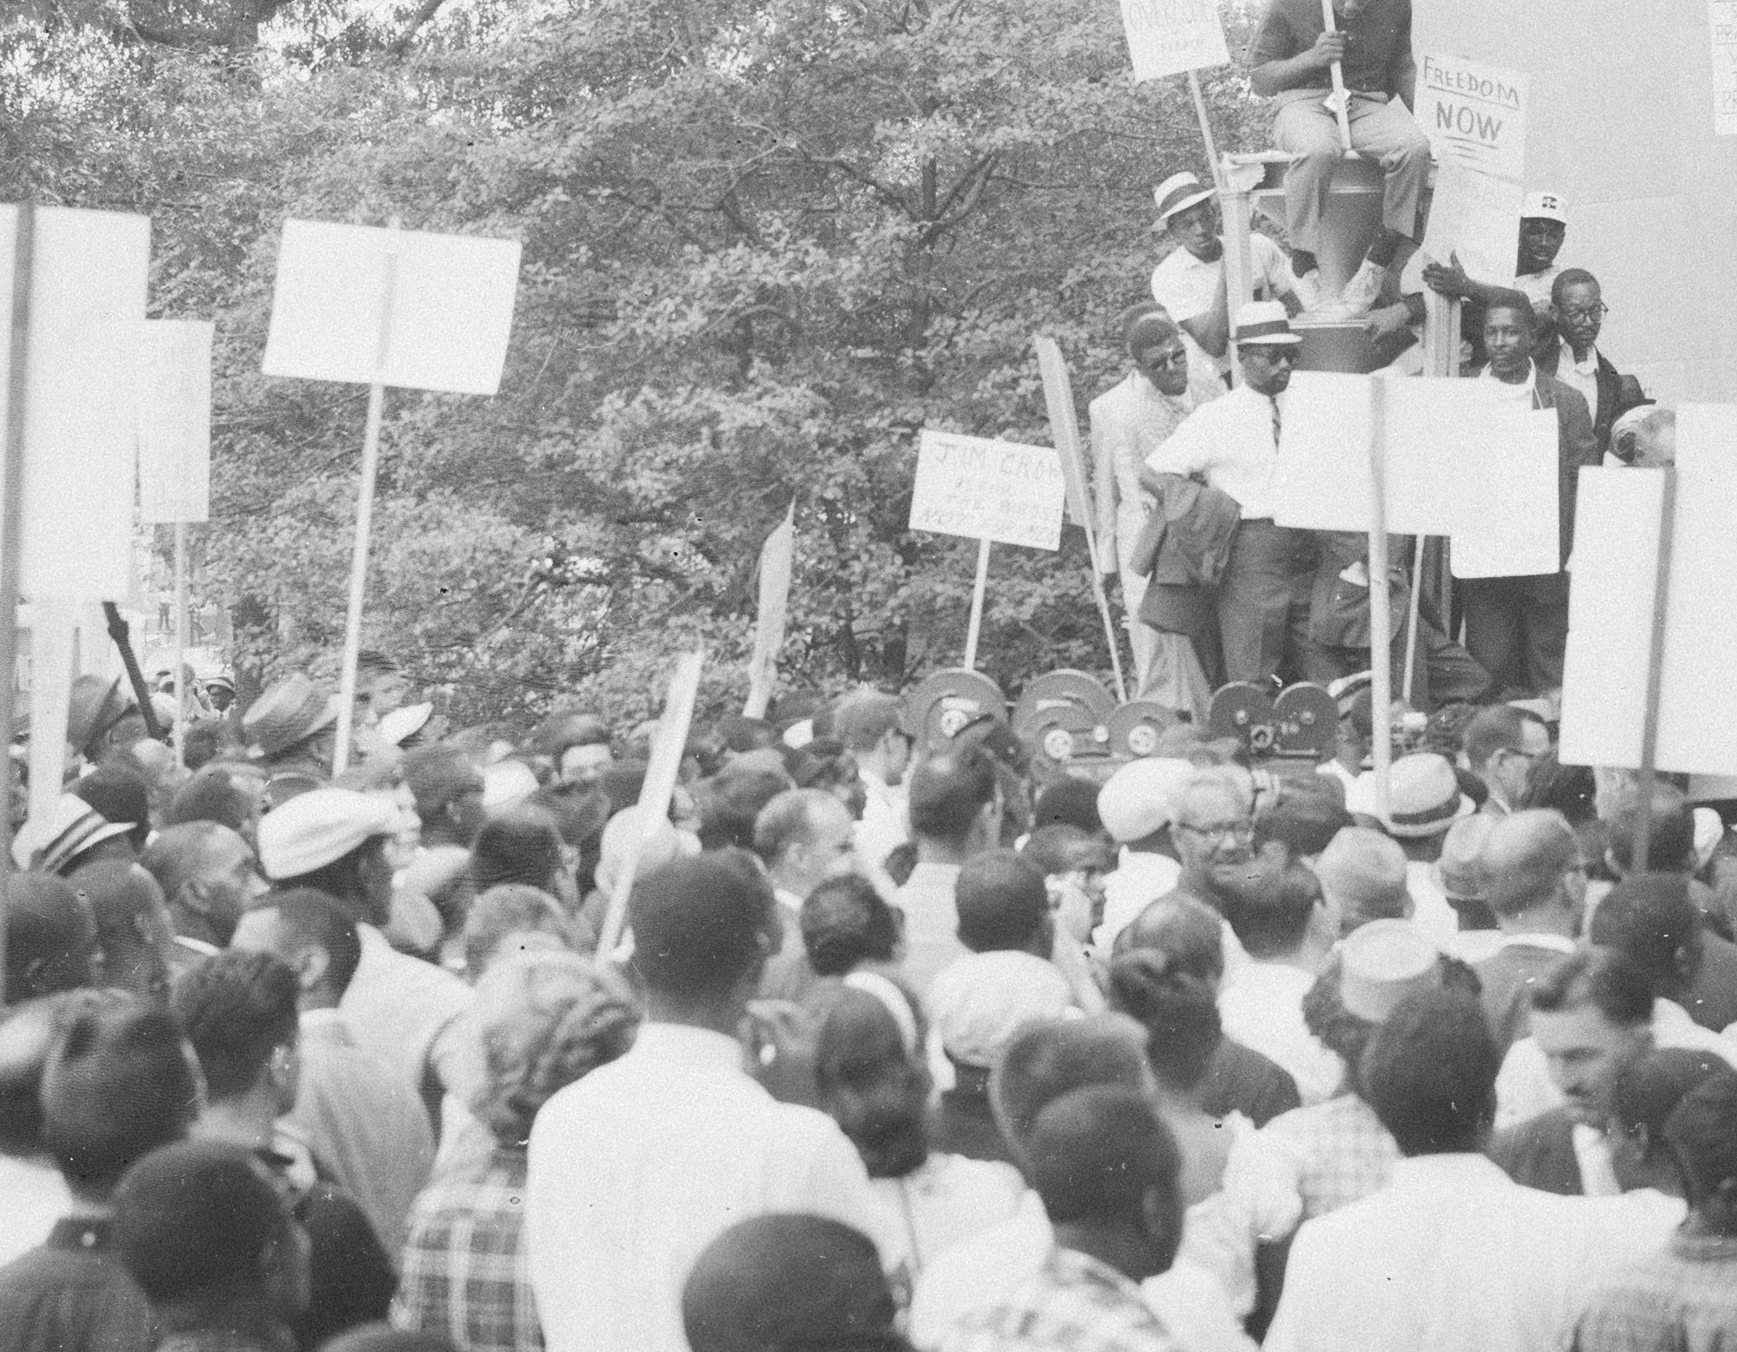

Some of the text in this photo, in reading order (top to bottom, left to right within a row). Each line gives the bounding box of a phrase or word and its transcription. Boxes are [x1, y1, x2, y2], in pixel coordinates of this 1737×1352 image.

[1424, 56, 1520, 107] FREEDOM
[1436, 101, 1503, 141] NOW
[935, 440, 987, 469] JIM
